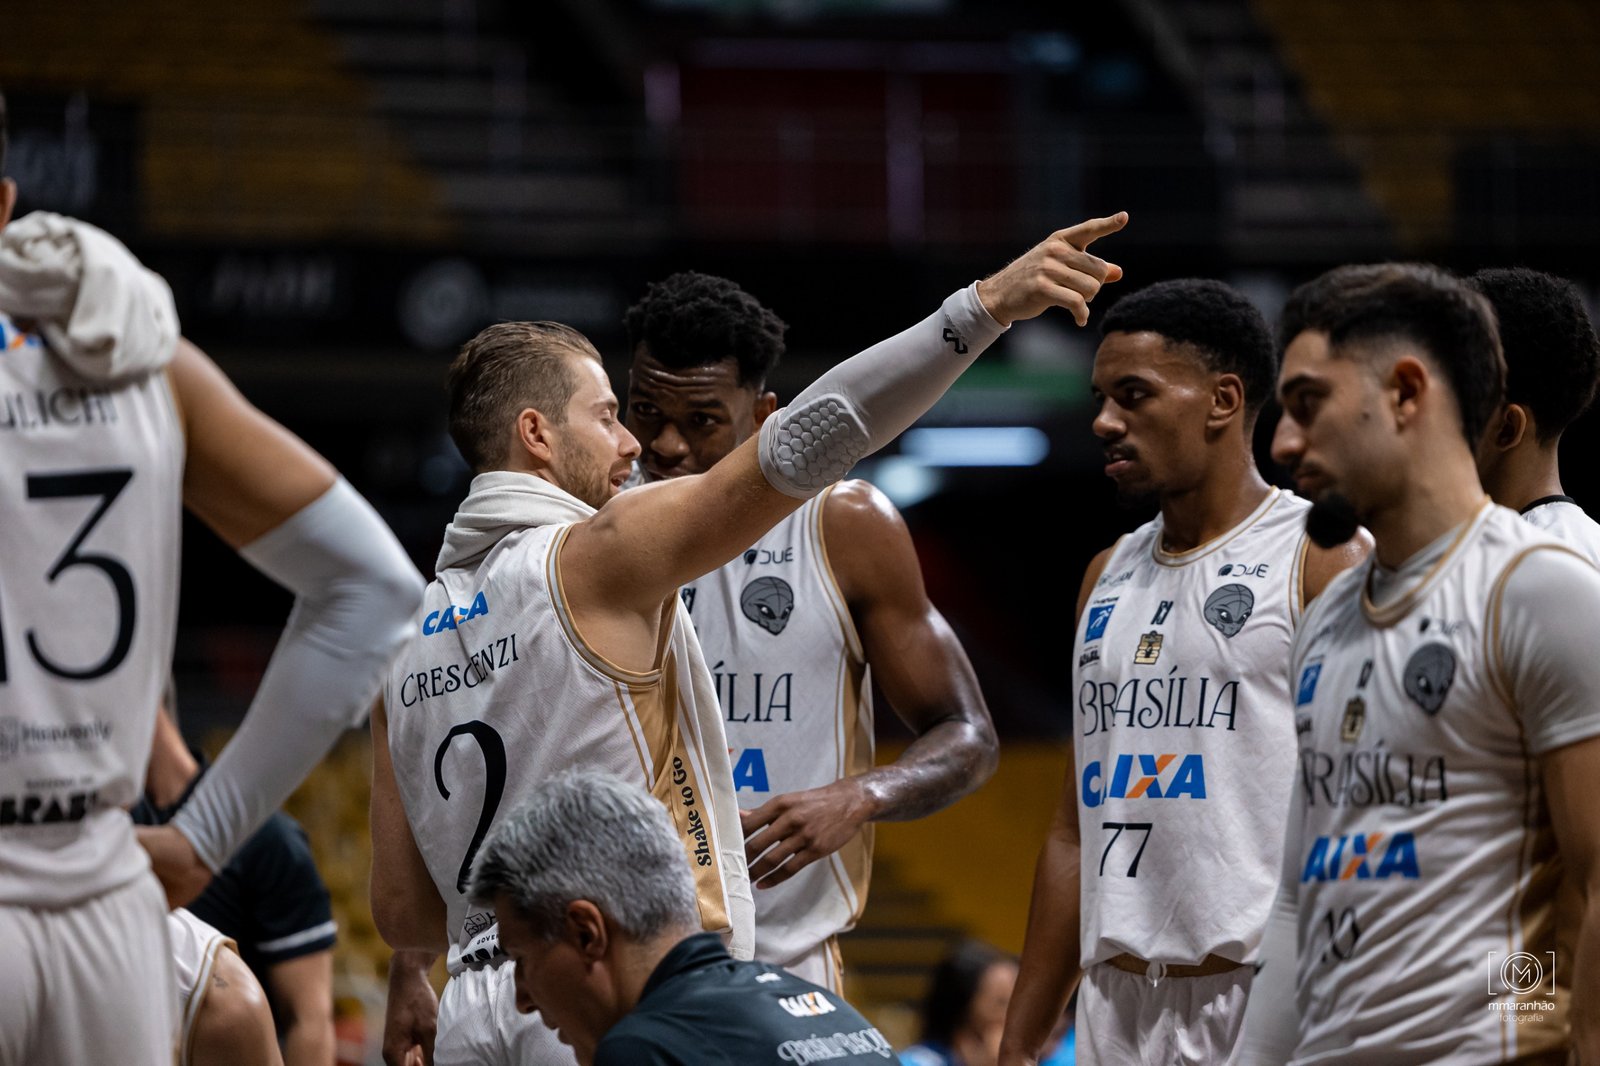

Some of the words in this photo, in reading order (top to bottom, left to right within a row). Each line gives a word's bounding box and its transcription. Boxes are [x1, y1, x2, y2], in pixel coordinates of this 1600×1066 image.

[0, 467, 137, 684] 3
[401, 633, 519, 708] CRESCENZI
[713, 660, 793, 723] ÍLIA
[1079, 665, 1240, 736] BRASÍLIA
[673, 756, 687, 785] Go
[682, 786, 695, 807] to
[1082, 754, 1207, 808] CIXA
[687, 809, 712, 867] Shake
[1099, 822, 1153, 878] 77
[1302, 831, 1421, 884] AIXA
